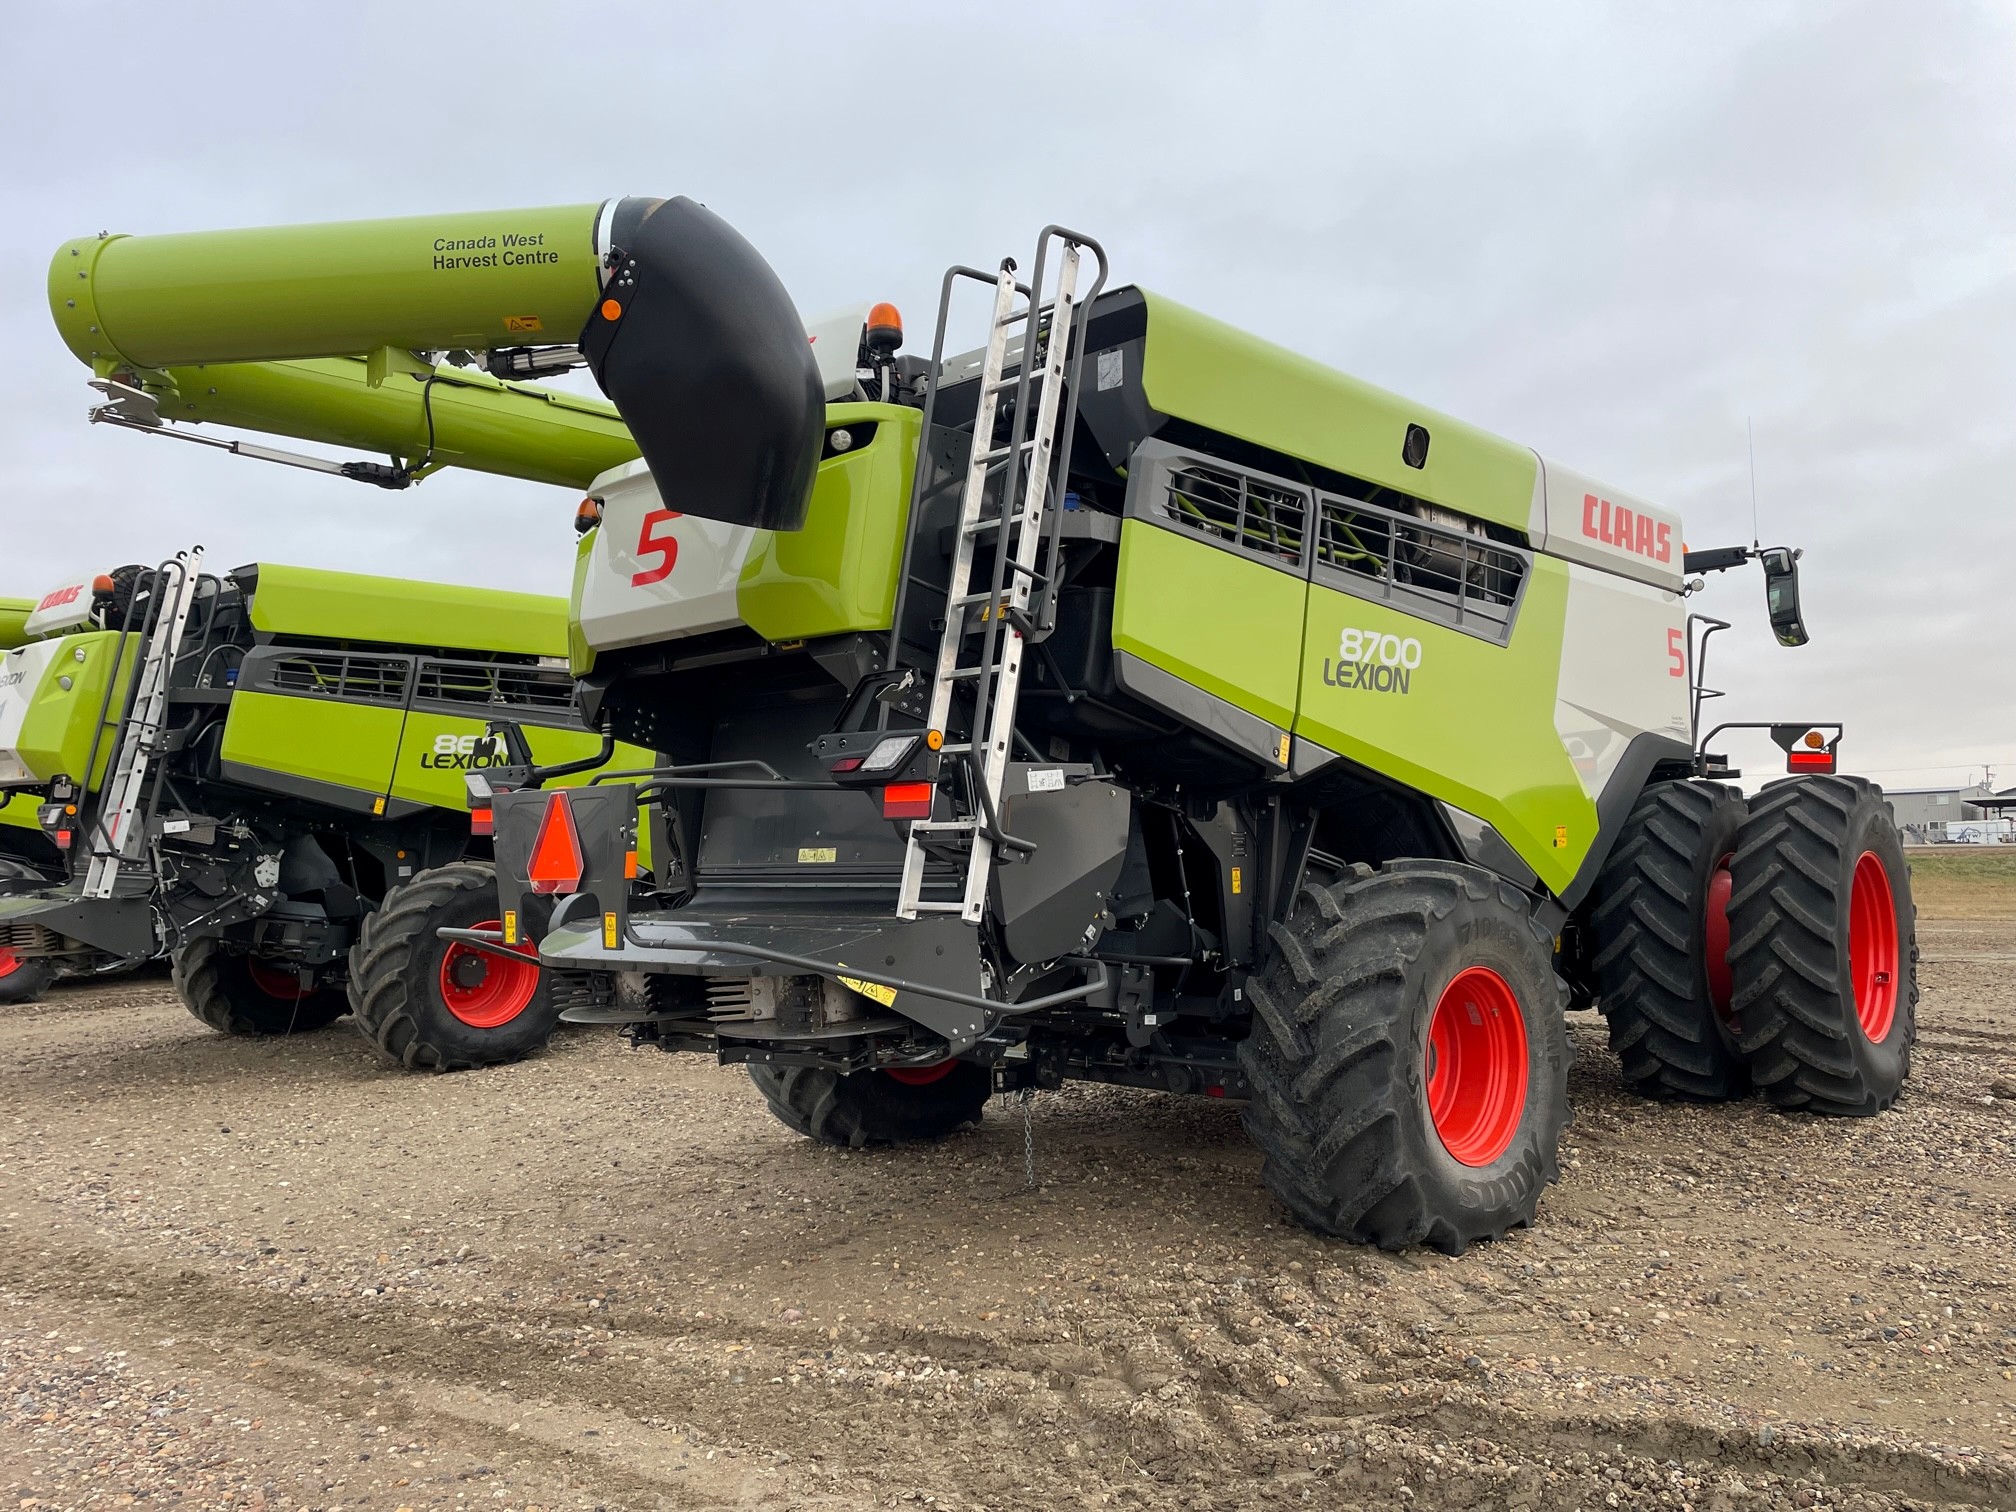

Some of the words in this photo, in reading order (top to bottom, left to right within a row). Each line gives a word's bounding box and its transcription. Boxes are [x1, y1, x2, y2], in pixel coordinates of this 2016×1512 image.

[433, 236, 496, 251] Canada
[502, 233, 544, 247] West
[433, 252, 498, 269] Harvest
[502, 250, 559, 266] Centre
[631, 508, 683, 588] 5
[1582, 493, 1671, 564] CLAAS
[1339, 627, 1422, 670] 8700
[1667, 627, 1684, 678] 5
[1323, 657, 1410, 695] LEXION
[420, 752, 510, 769] LEXION
